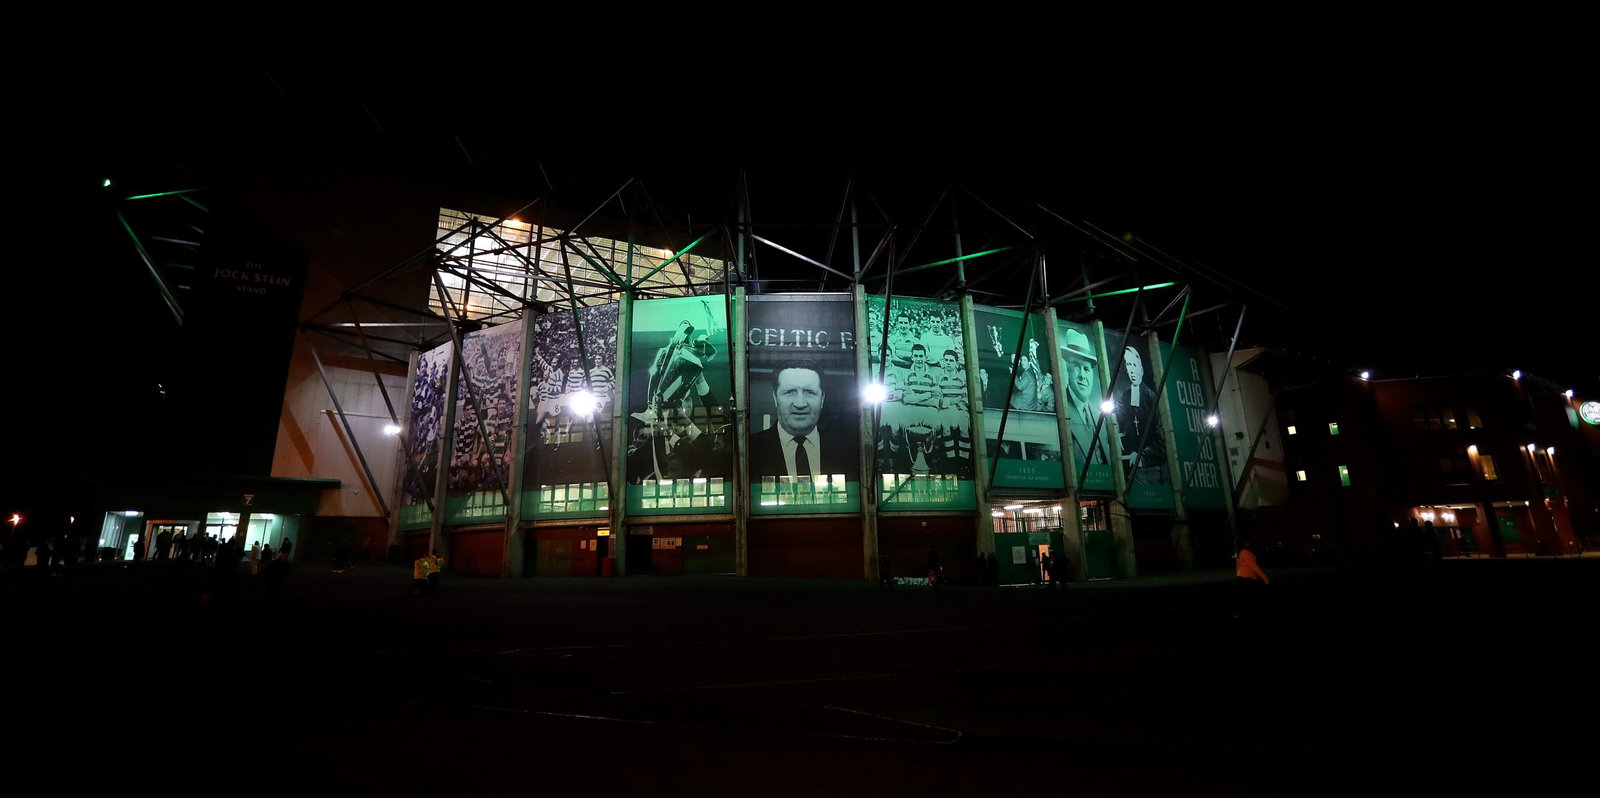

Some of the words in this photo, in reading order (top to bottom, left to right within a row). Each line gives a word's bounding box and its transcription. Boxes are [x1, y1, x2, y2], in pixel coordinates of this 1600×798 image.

[245, 260, 262, 270] THE
[213, 267, 250, 280] JOCK
[254, 273, 291, 287] STEIN
[235, 284, 268, 294] STAND
[748, 327, 830, 349] CELTIC
[1189, 357, 1200, 381] A
[1176, 380, 1205, 408] CLUB
[1183, 461, 1220, 488] OTHER
[243, 493, 256, 506] 7
